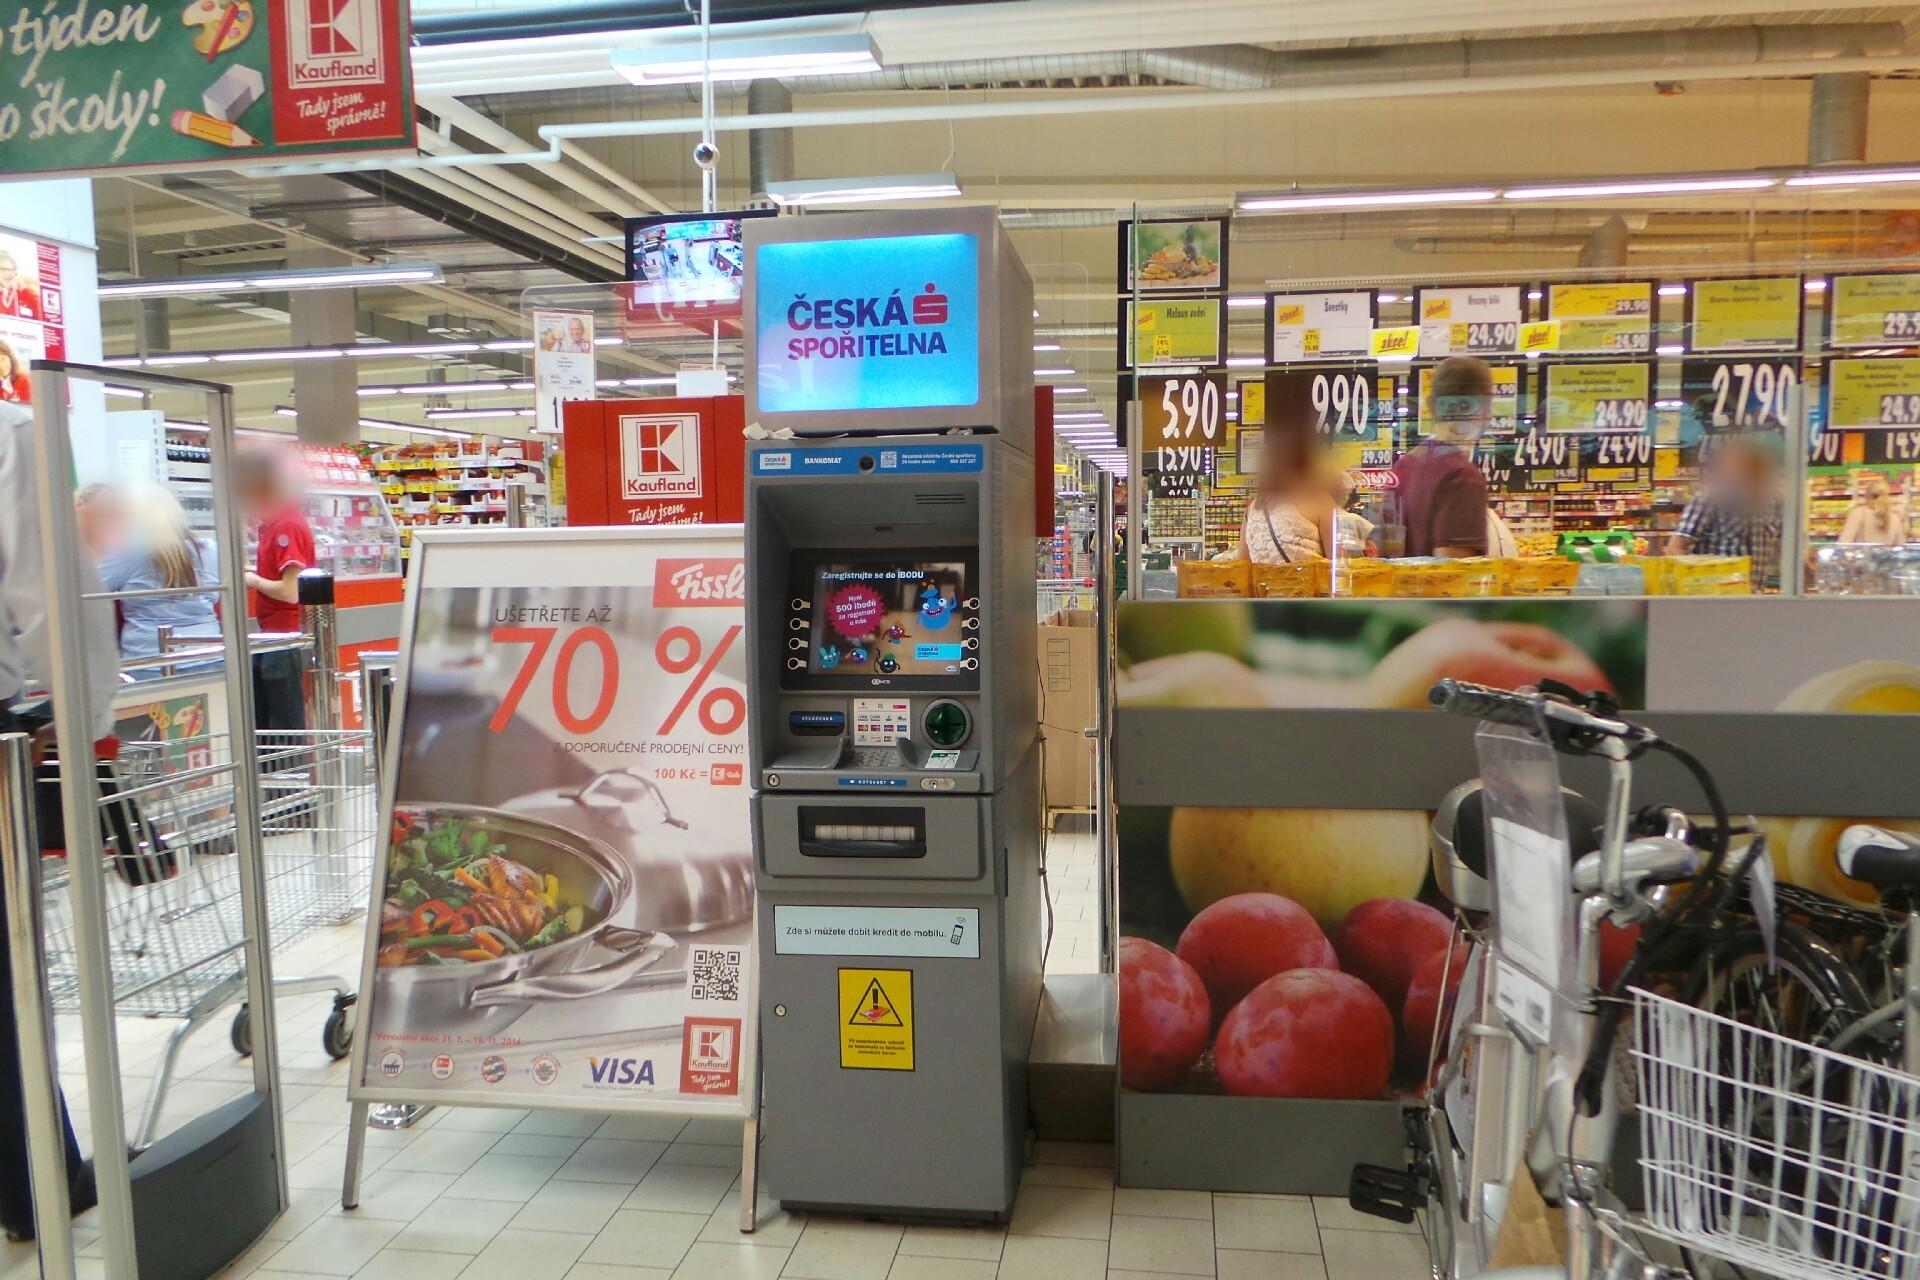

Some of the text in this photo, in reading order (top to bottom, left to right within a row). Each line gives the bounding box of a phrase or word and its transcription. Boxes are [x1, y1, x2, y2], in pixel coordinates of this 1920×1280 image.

[10, 0, 161, 88] týden
[295, 57, 377, 80] Kaufland
[0, 69, 168, 163] o školy!
[296, 91, 365, 119] Tady jsem
[325, 100, 387, 137] správně!
[787, 289, 909, 331] ČESKÁ
[1468, 323, 1516, 346] 24.90
[1884, 312, 1920, 335] 29.9
[788, 331, 948, 361] SPOŘITELNA
[1380, 331, 1409, 351] akce!
[1162, 379, 1219, 439] 5.90
[1311, 374, 1369, 435] 9.90
[1595, 400, 1647, 427] 24.90
[1880, 395, 1920, 423] 24.9
[804, 457, 842, 465] BANKOMAT
[1361, 450, 1391, 465] 29.90
[627, 476, 697, 494] Kaufland
[628, 503, 685, 523] Tady jsem
[821, 571, 873, 581] Zaregistrujte
[495, 605, 613, 622] UŠETŘETE AŽ
[836, 603, 852, 613] 500
[488, 625, 746, 735] 70 %
[564, 741, 647, 753] DOPORUČENÉ
[650, 742, 705, 756] PRODEJNÍ
[708, 743, 744, 754] CENY!
[654, 768, 676, 779] 100
[680, 767, 697, 780] Kč
[786, 927, 803, 935] Zde
[804, 927, 812, 935] si
[814, 927, 846, 937] můžete
[872, 928, 899, 937] kredit
[900, 929, 912, 937] do
[586, 1056, 656, 1086] VISA
[691, 1059, 729, 1070] Kaufland
